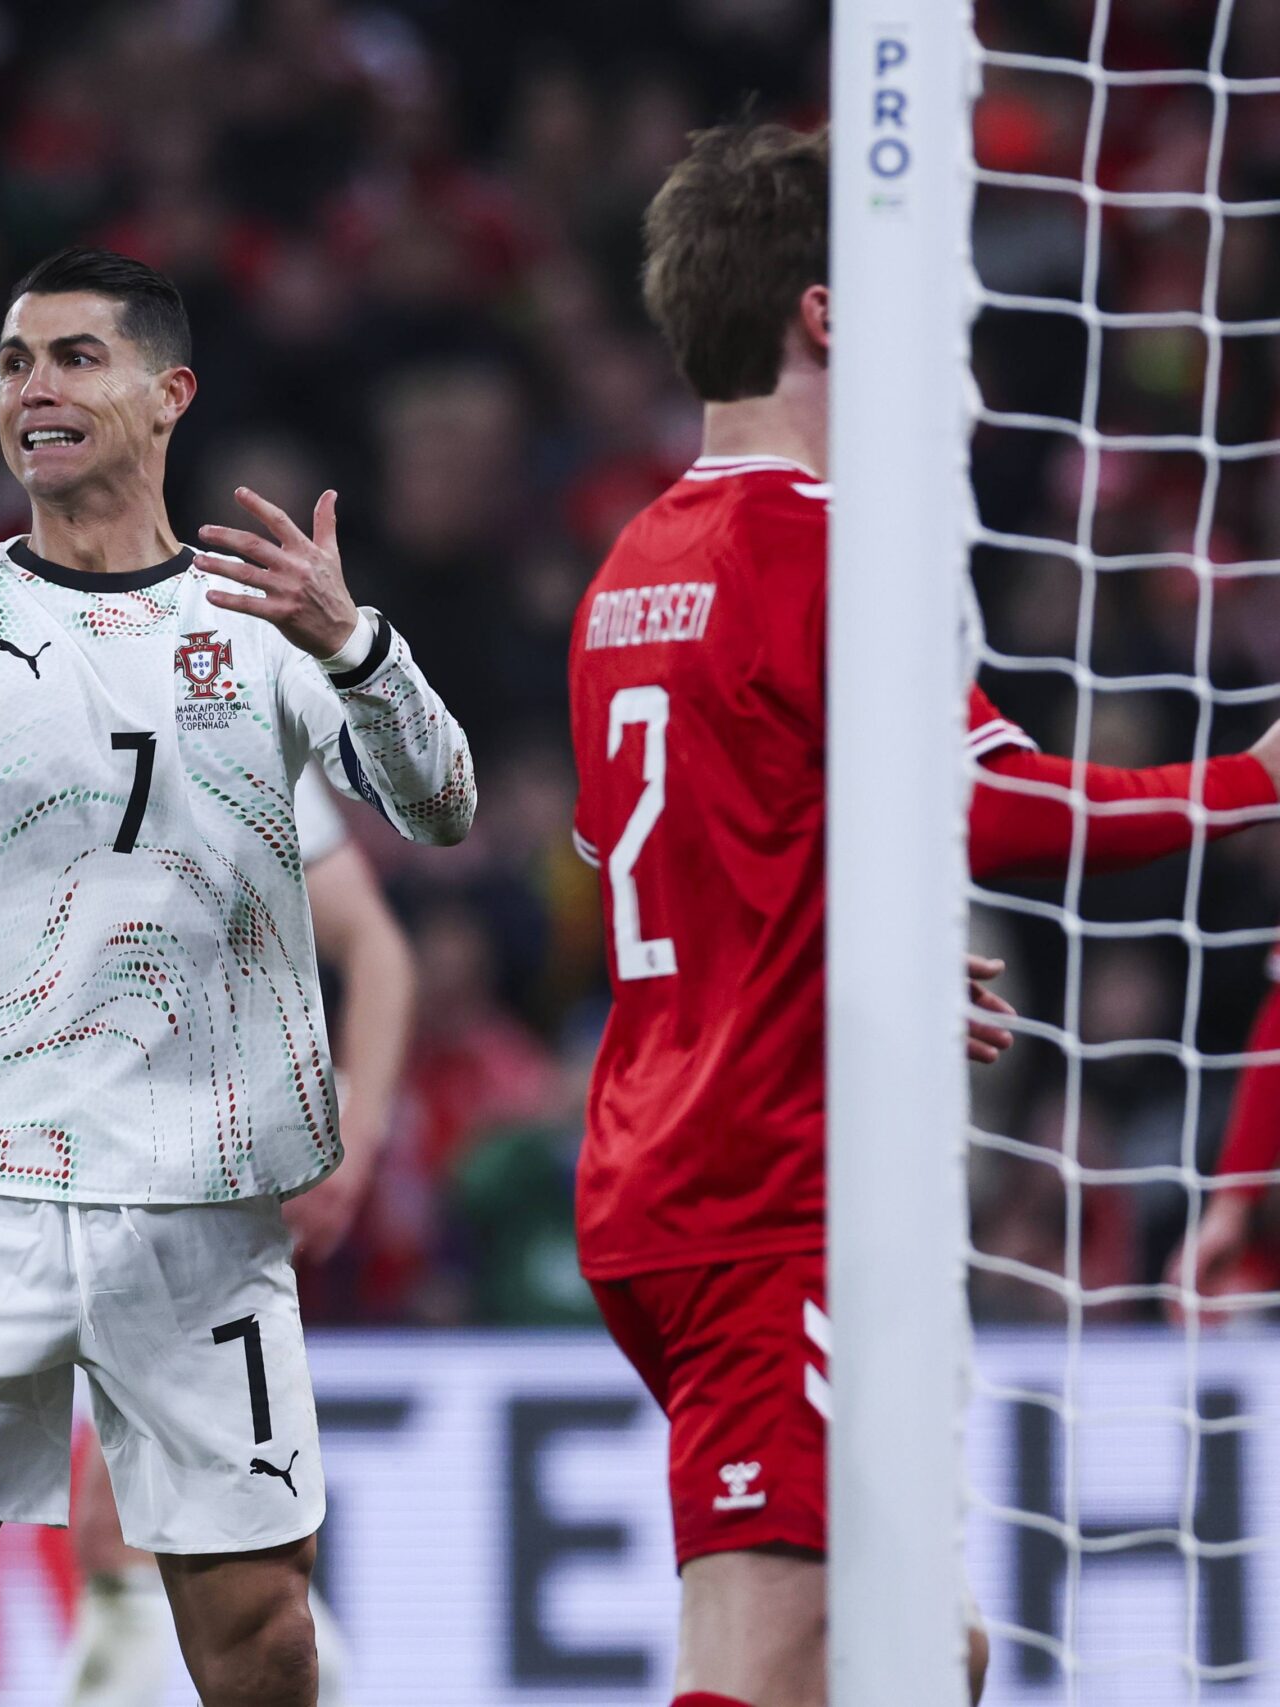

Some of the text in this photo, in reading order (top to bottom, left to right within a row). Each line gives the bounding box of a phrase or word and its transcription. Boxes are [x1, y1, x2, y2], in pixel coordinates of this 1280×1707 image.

[869, 38, 911, 179] PRO
[584, 581, 718, 652] ANDERSEN
[174, 701, 251, 714] MARCA/PORTUGAL
[181, 720, 230, 731] COPENHAGA
[217, 710, 238, 720] 2025
[111, 731, 157, 854] 7
[607, 684, 679, 981] 2
[211, 1313, 273, 1446] 7
